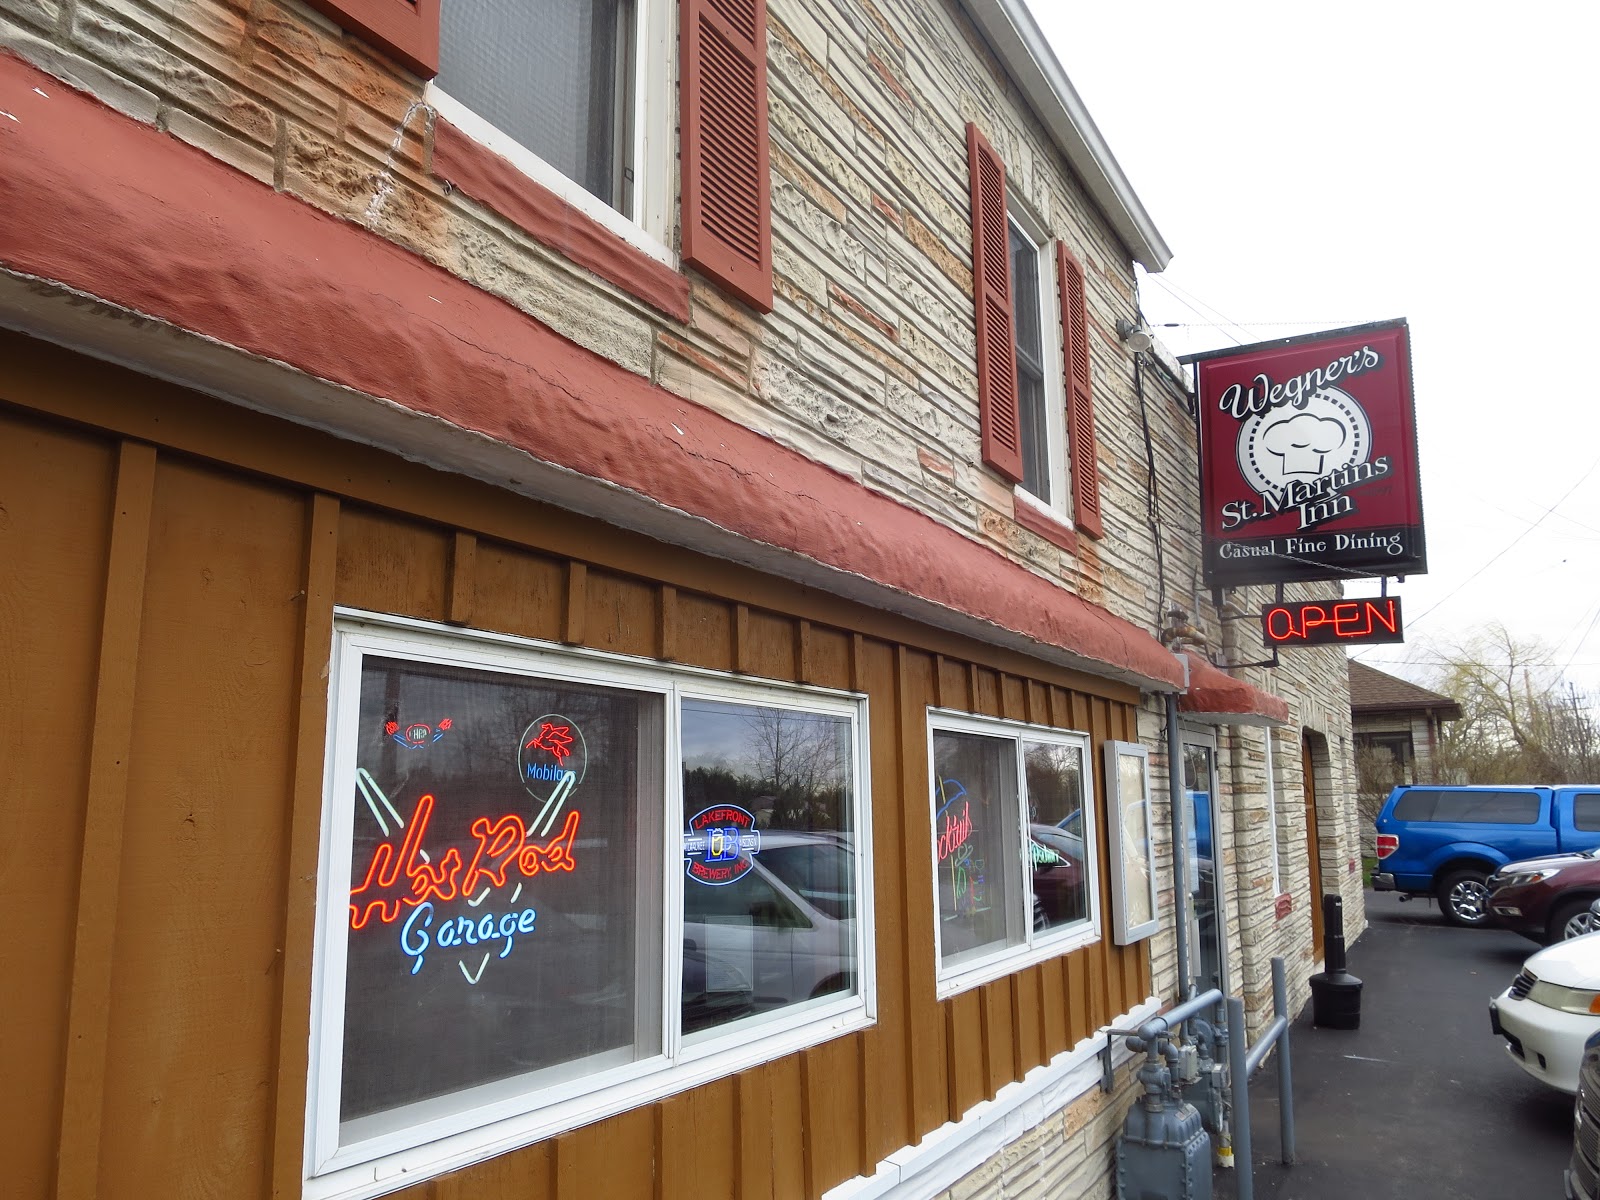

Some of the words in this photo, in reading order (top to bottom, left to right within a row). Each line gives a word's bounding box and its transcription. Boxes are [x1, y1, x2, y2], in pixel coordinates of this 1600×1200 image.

[1219, 346, 1379, 419] Wegner's
[1298, 495, 1353, 529] Inn
[1220, 540, 1276, 559] Casual
[1286, 537, 1326, 554] Fine
[1335, 532, 1403, 555] Dining
[1267, 600, 1396, 640] OPEN
[694, 810, 750, 829] LAKEFRONT
[401, 901, 537, 975] Garage
